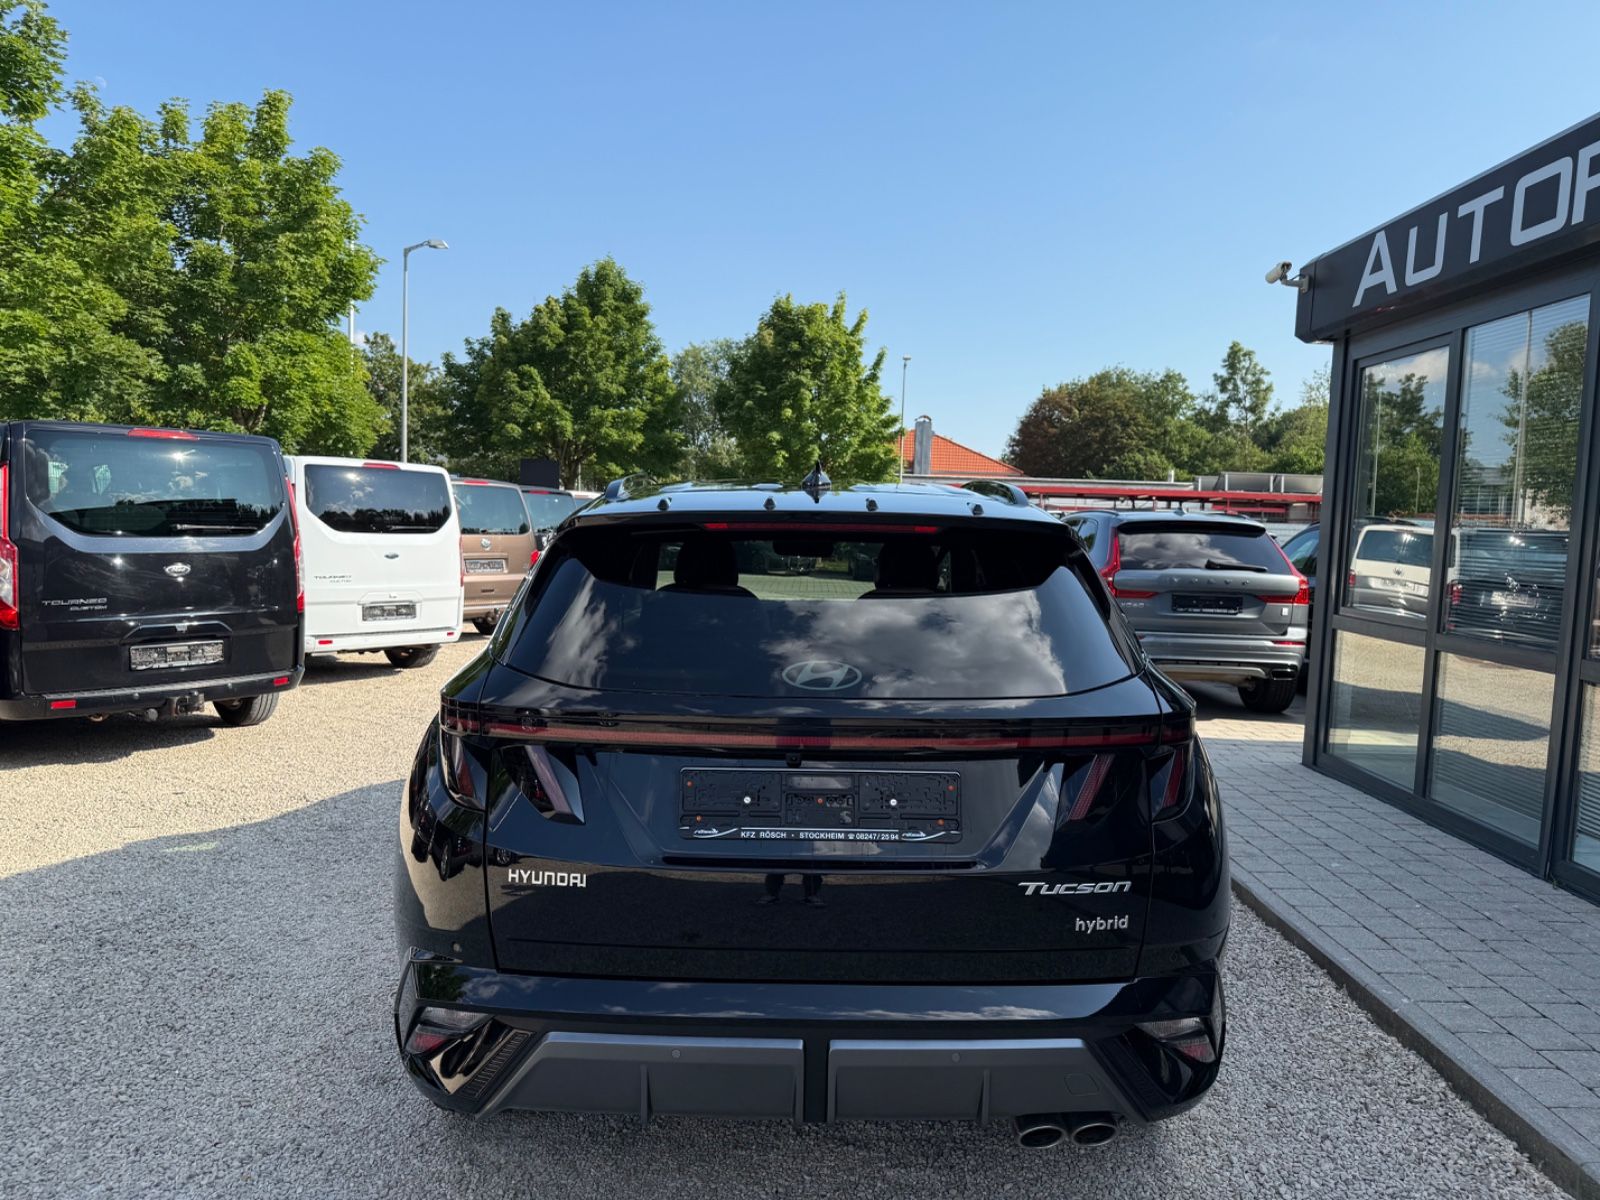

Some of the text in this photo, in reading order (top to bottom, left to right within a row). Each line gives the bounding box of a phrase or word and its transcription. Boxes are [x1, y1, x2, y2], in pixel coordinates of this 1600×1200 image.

[740, 831, 756, 839] KFZ
[759, 830, 787, 839] RÖSCH
[799, 832, 845, 840] STOCKHEIM
[508, 868, 587, 888] HYUNDAI
[1075, 914, 1129, 935] hybrid
